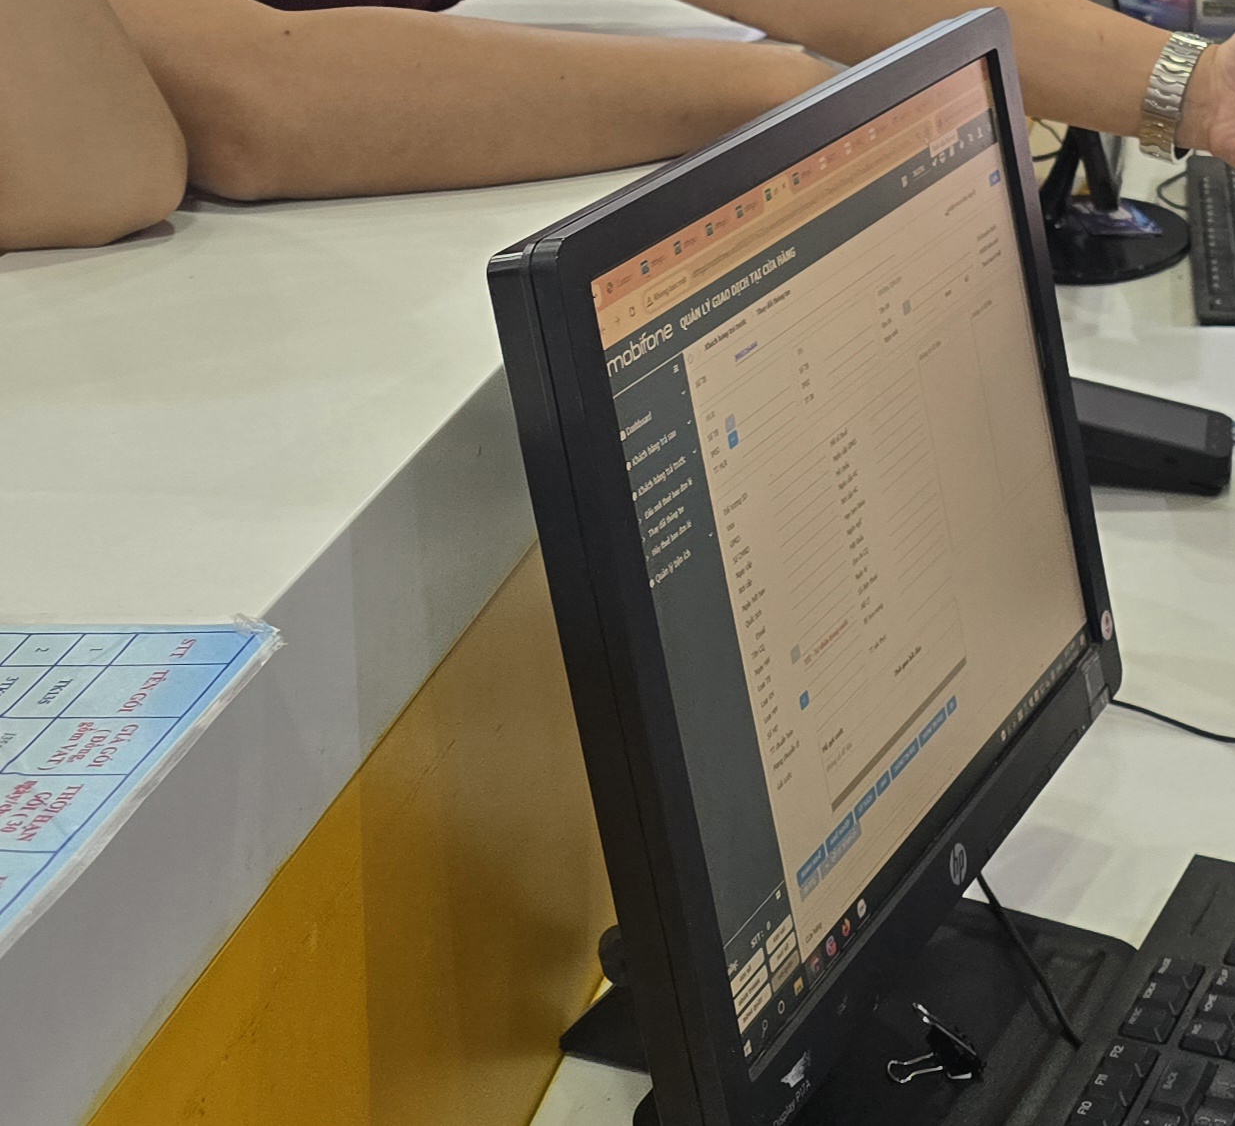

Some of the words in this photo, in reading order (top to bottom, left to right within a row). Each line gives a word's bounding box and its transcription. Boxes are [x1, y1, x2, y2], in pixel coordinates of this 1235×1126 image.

[679, 307, 701, 330] QUẢN
[701, 298, 710, 315] LÝ
[711, 288, 730, 307] GIAO
[606, 322, 674, 377] mobifone
[169, 638, 196, 658] STT
[141, 669, 170, 690] TÊN
[38, 678, 73, 705] TK135
[117, 692, 148, 713] GÓI
[108, 724, 139, 745] GIÁ
[47, 744, 78, 765] VAT
[86, 747, 118, 768] GÓI
[26, 791, 54, 810] GÓI
[43, 784, 85, 813] THỜI
[17, 814, 56, 841] HẠN
[1109, 1045, 1125, 1058] F12
[1094, 1074, 1108, 1086] F11
[1077, 1100, 1092, 1115] F10
